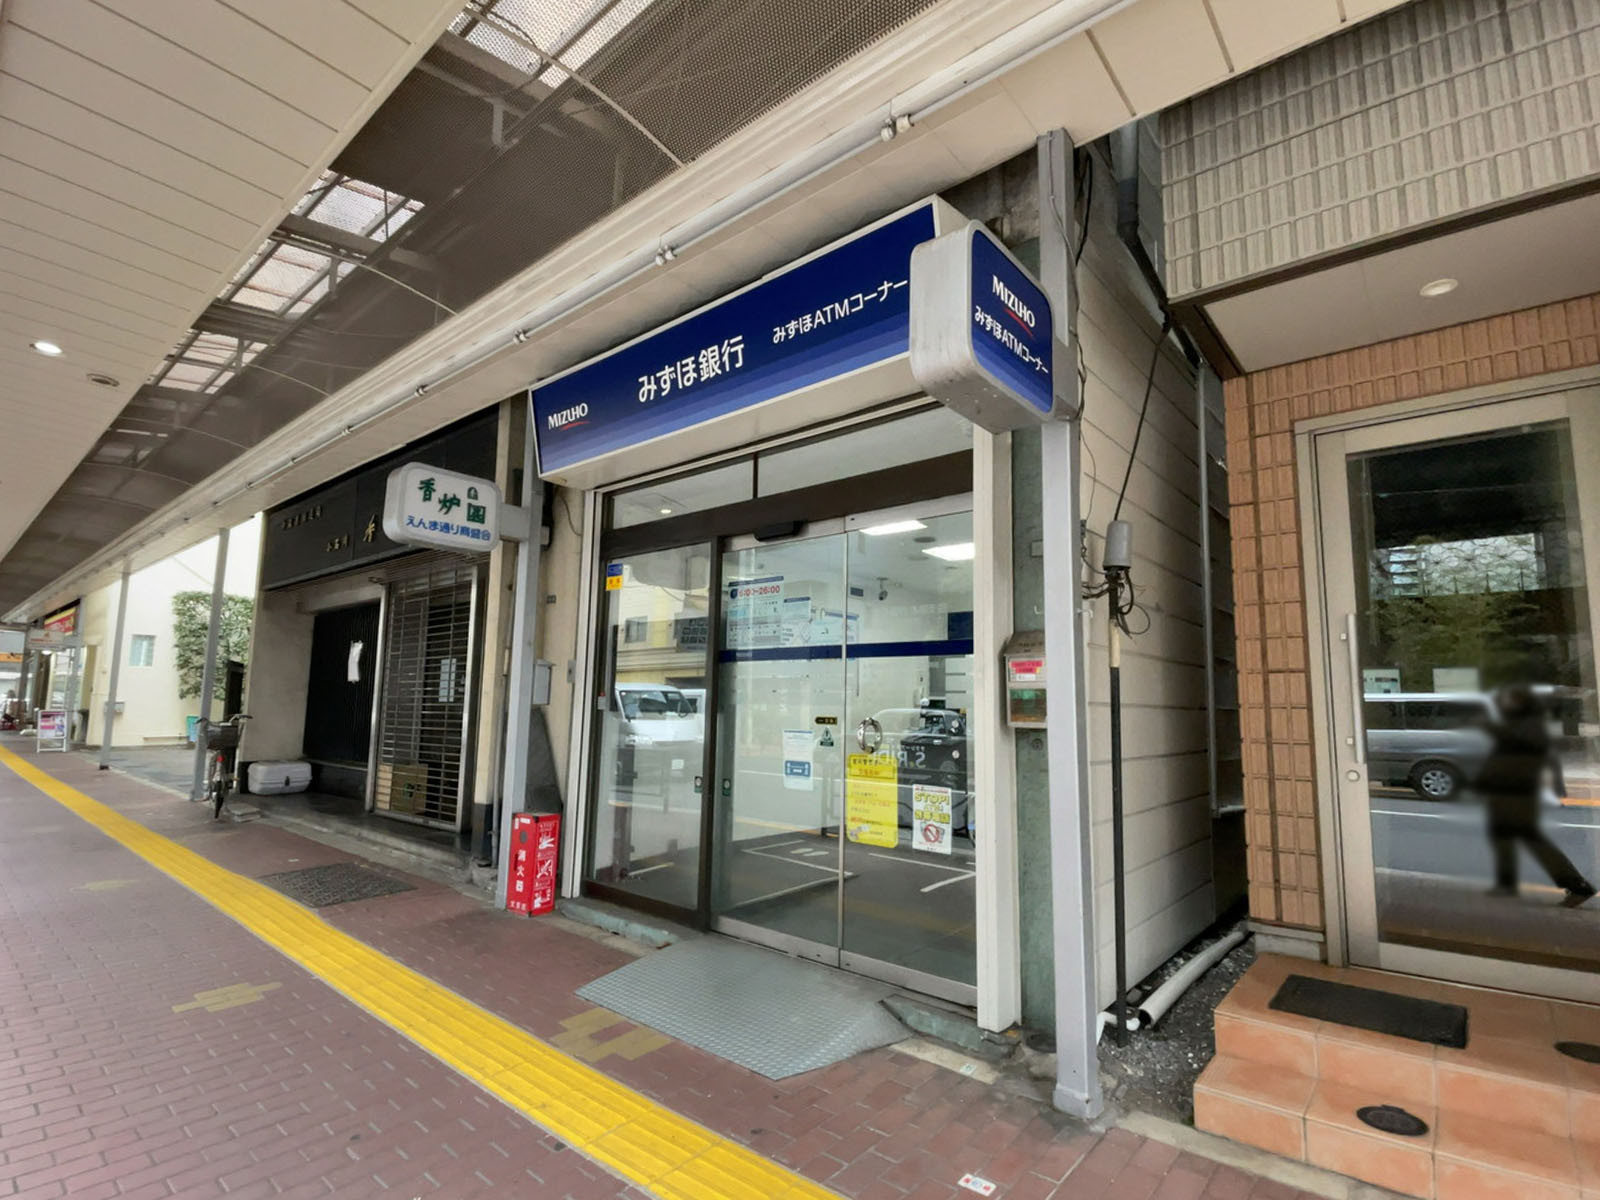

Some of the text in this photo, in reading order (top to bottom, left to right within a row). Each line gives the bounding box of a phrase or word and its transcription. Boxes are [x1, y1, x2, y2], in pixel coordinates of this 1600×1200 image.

[772, 279, 909, 344] みずほATMコーナー
[992, 274, 1036, 328] MIZUHO
[637, 335, 746, 404] みずほ銀行
[974, 305, 1049, 374] みずほATMコーナー
[547, 403, 588, 429] MIZUHO
